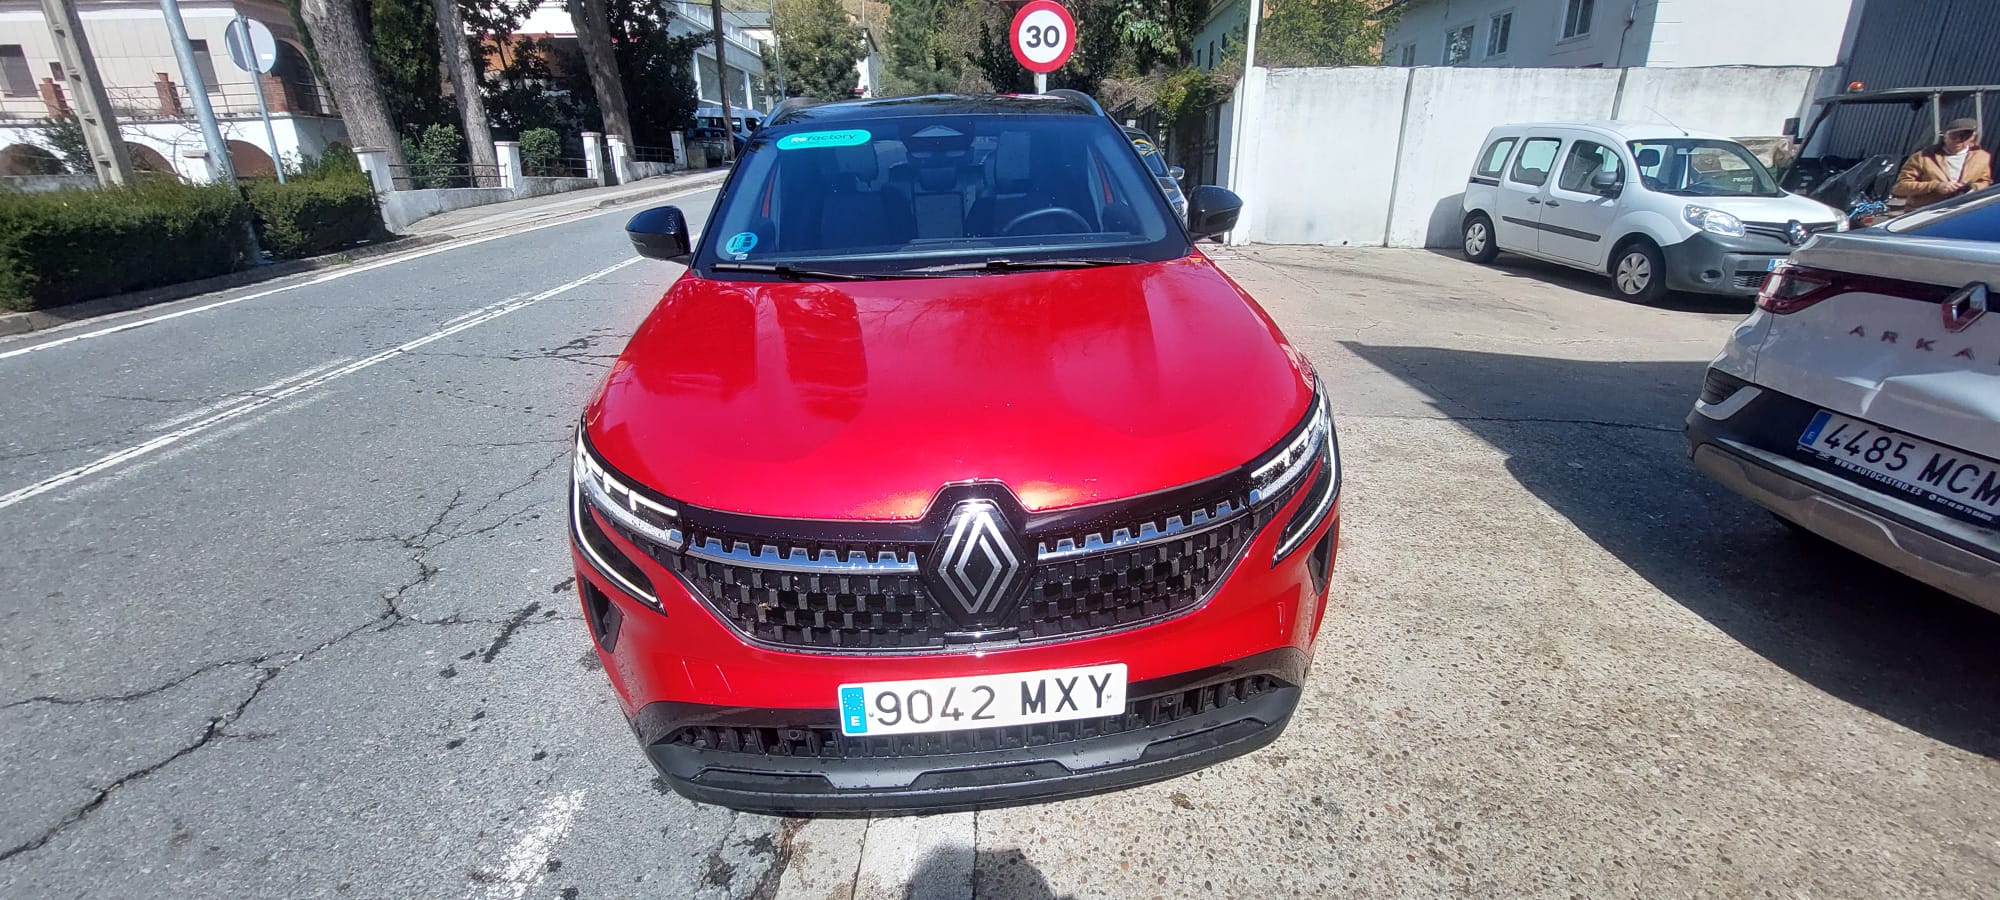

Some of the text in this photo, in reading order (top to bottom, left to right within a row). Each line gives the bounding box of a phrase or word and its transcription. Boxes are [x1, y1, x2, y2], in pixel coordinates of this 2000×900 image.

[1026, 25, 1060, 48] 30
[1848, 324, 2000, 366] ARKA
[1824, 423, 2000, 506] 4485 MCM
[875, 673, 1112, 726] 9042 MXY
[851, 716, 861, 727] E
